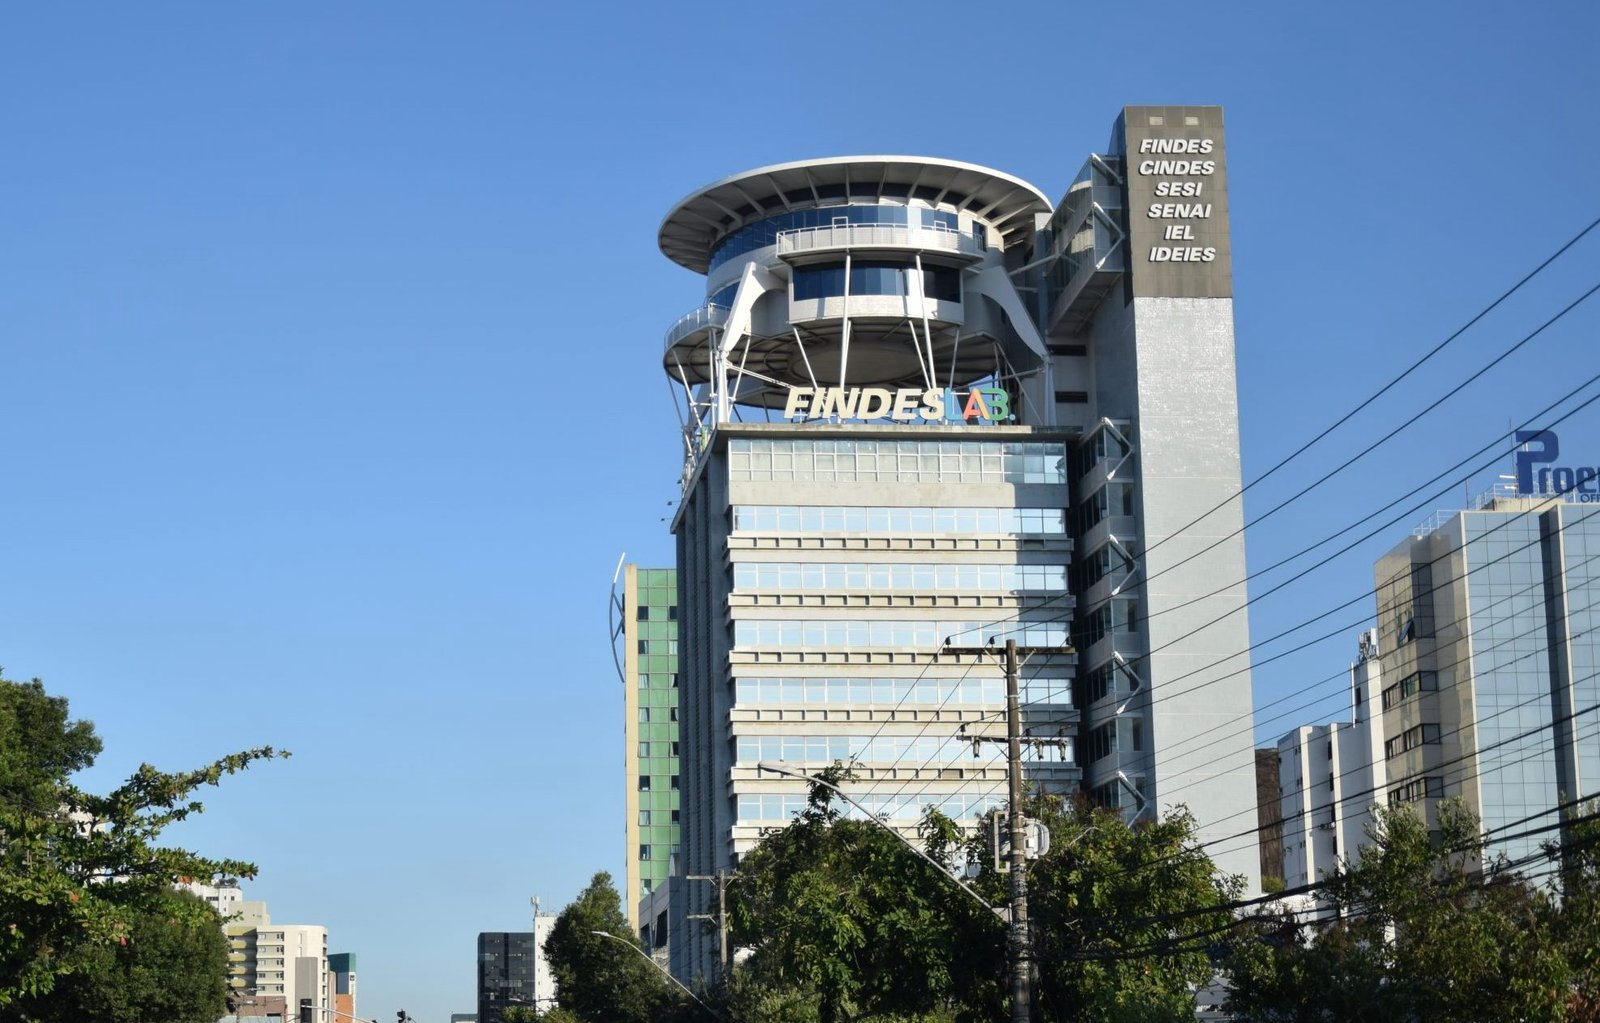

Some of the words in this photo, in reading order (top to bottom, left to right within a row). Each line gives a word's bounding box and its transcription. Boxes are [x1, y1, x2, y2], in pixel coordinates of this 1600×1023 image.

[1140, 138, 1214, 154] FINDES
[1139, 160, 1215, 175] CINDES
[1155, 181, 1203, 197] SESI
[1148, 203, 1212, 218] SENAI
[1164, 225, 1195, 240] IEL
[1149, 247, 1217, 262] IDEIES
[1515, 430, 1600, 494] Proe
